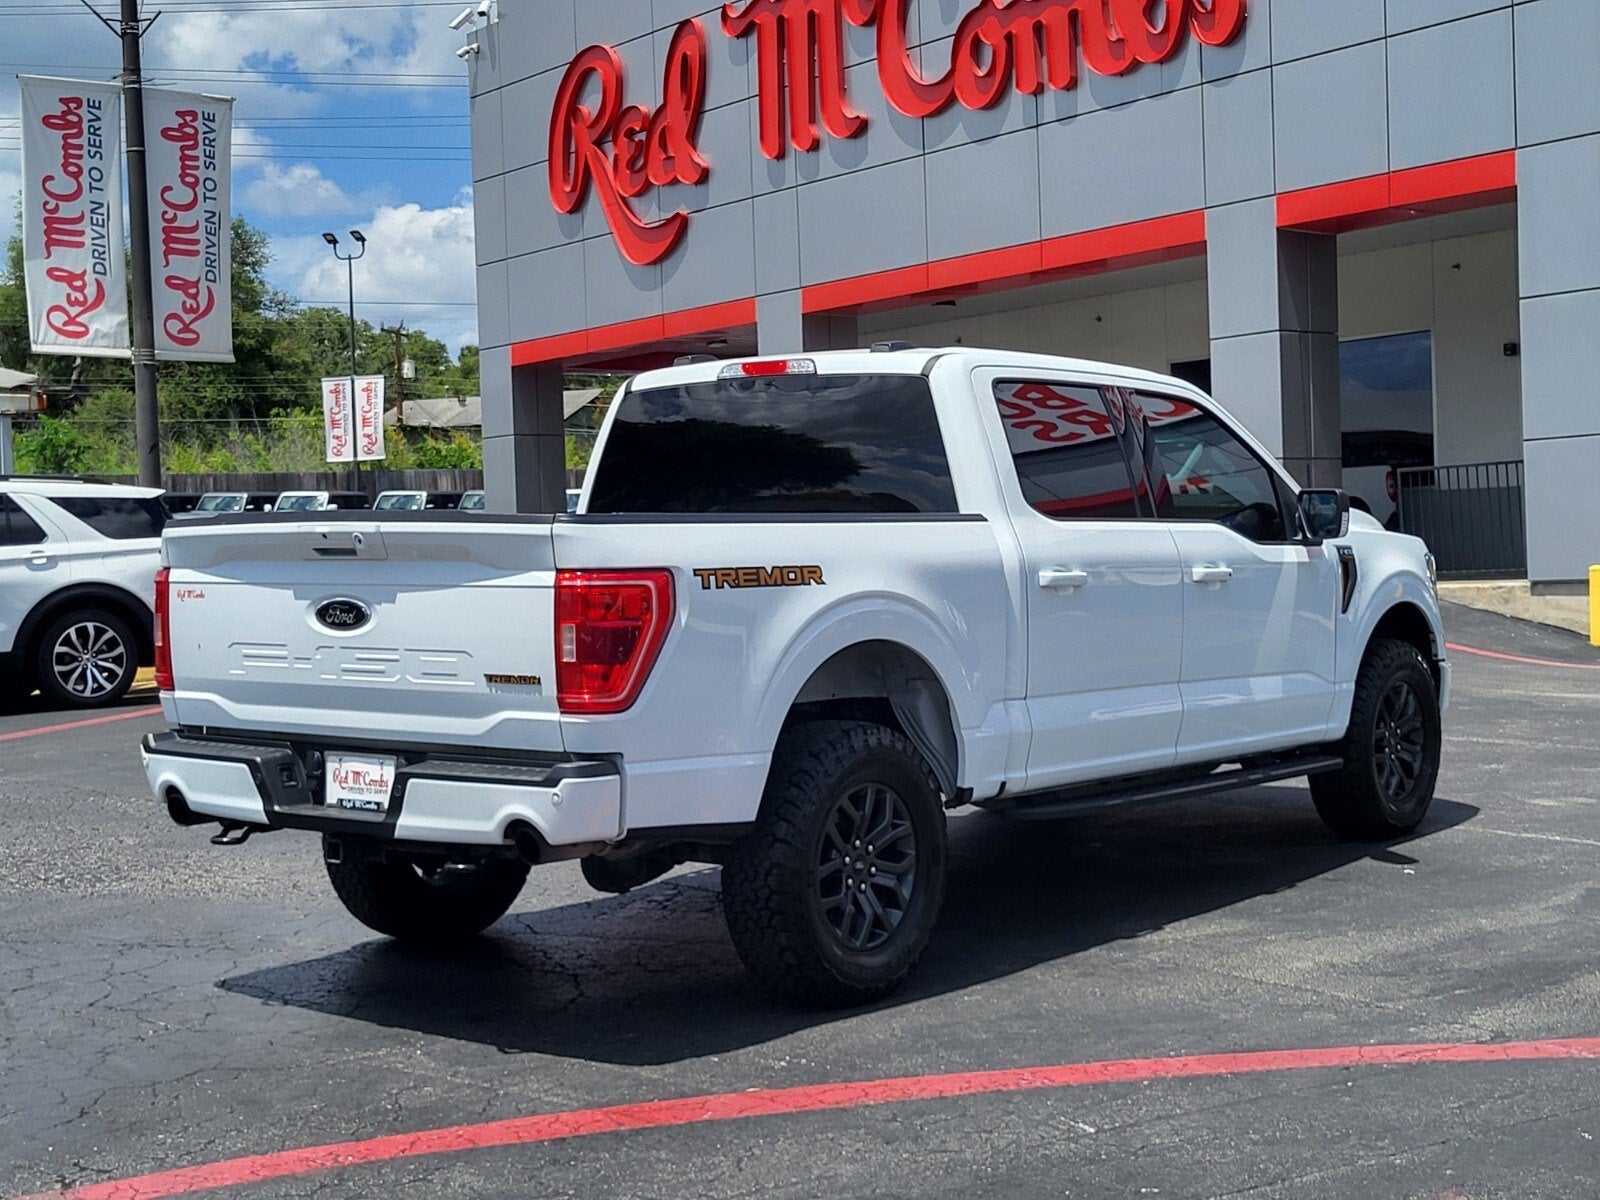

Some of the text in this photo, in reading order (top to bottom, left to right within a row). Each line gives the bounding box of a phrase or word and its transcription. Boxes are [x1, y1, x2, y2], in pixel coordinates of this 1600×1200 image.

[42, 96, 105, 339] Red McCombs
[87, 97, 108, 277] DRIVEN TO SERVE
[160, 109, 215, 347] Red McCombs
[201, 110, 219, 284] DRIVEN TO SERVE
[548, 18, 709, 265] Red
[325, 604, 357, 624] Ford
[693, 566, 826, 590] TREMOR
[484, 674, 541, 685] TREMOR
